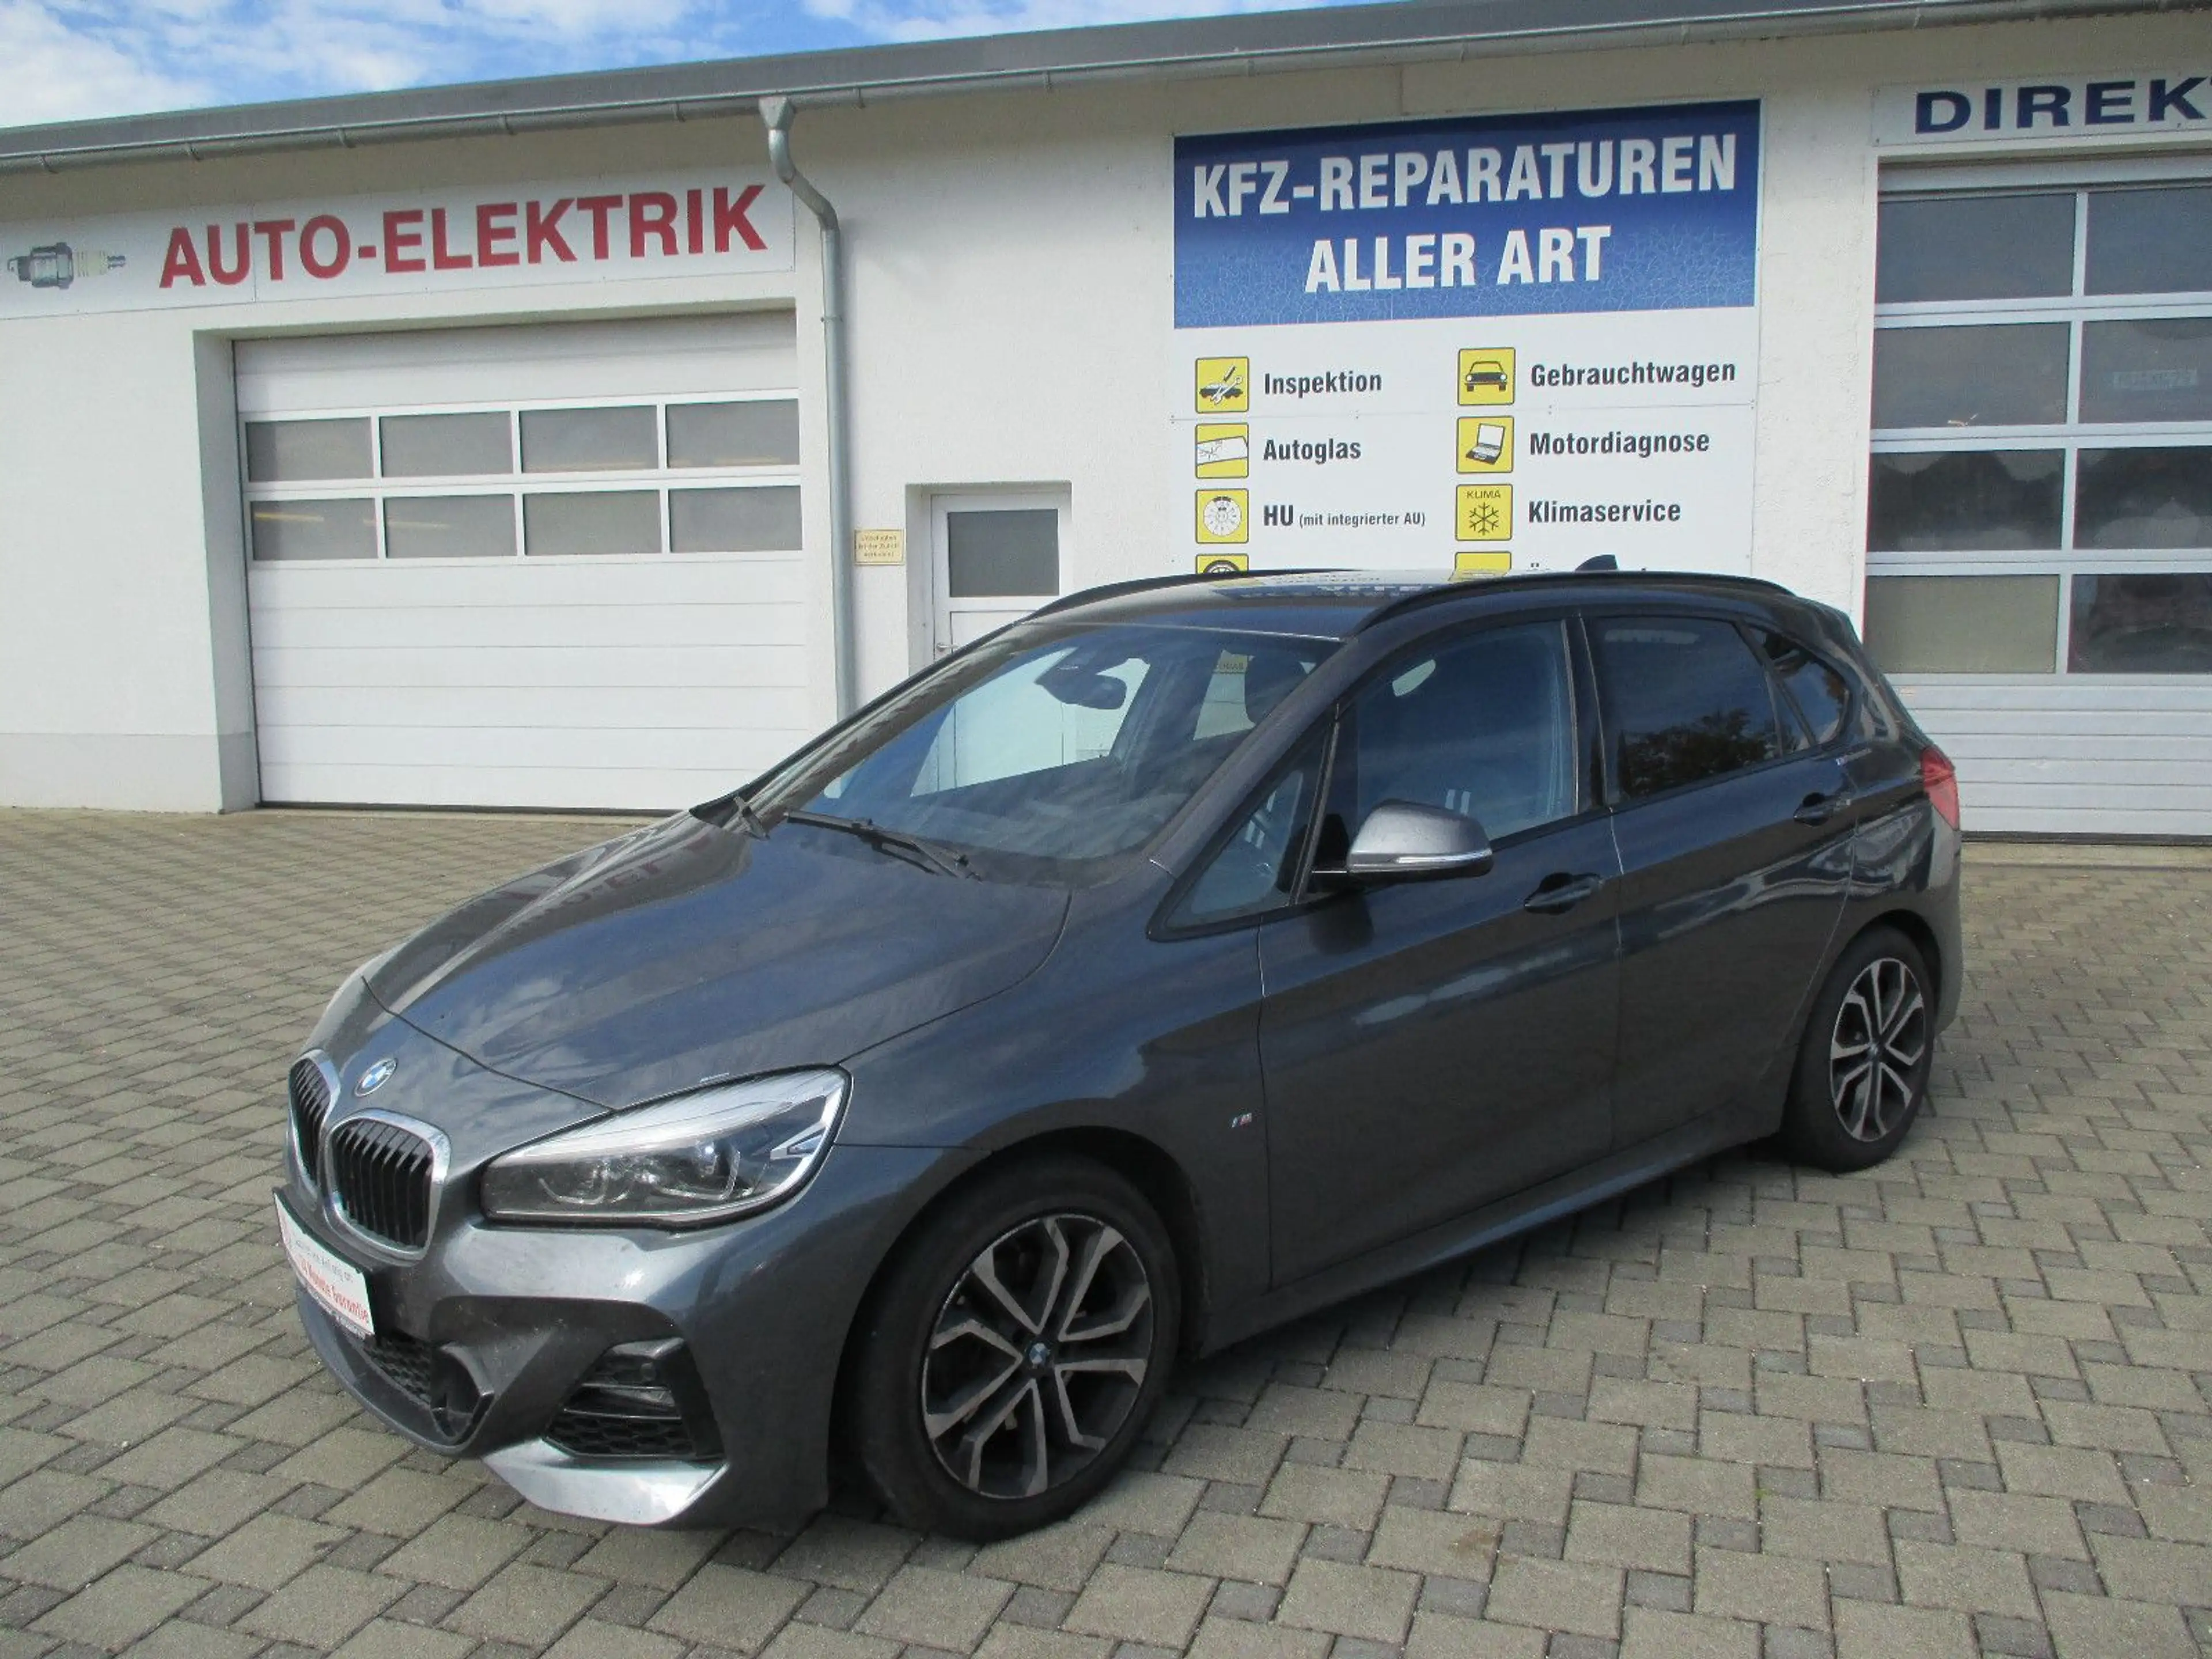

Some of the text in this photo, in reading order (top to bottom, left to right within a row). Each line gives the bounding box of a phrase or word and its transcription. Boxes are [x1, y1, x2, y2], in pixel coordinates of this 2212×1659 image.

[1915, 76, 2212, 134] DIREK
[1194, 133, 1737, 219] KFZ-REPARATUREN
[158, 184, 768, 289] AUTO-ELEKTRIK
[1304, 225, 1611, 294] ALLER ART
[1264, 370, 1382, 399] Inspektion
[1531, 361, 1737, 388] Gebrauchtwagen
[1263, 438, 1362, 465] Autoglas
[1529, 431, 1711, 459] Motordiagnose
[1466, 490, 1501, 499] KLIMA
[1263, 504, 1426, 529] HU (mit integrierter AU)
[1528, 499, 1681, 523] Klimaservice
